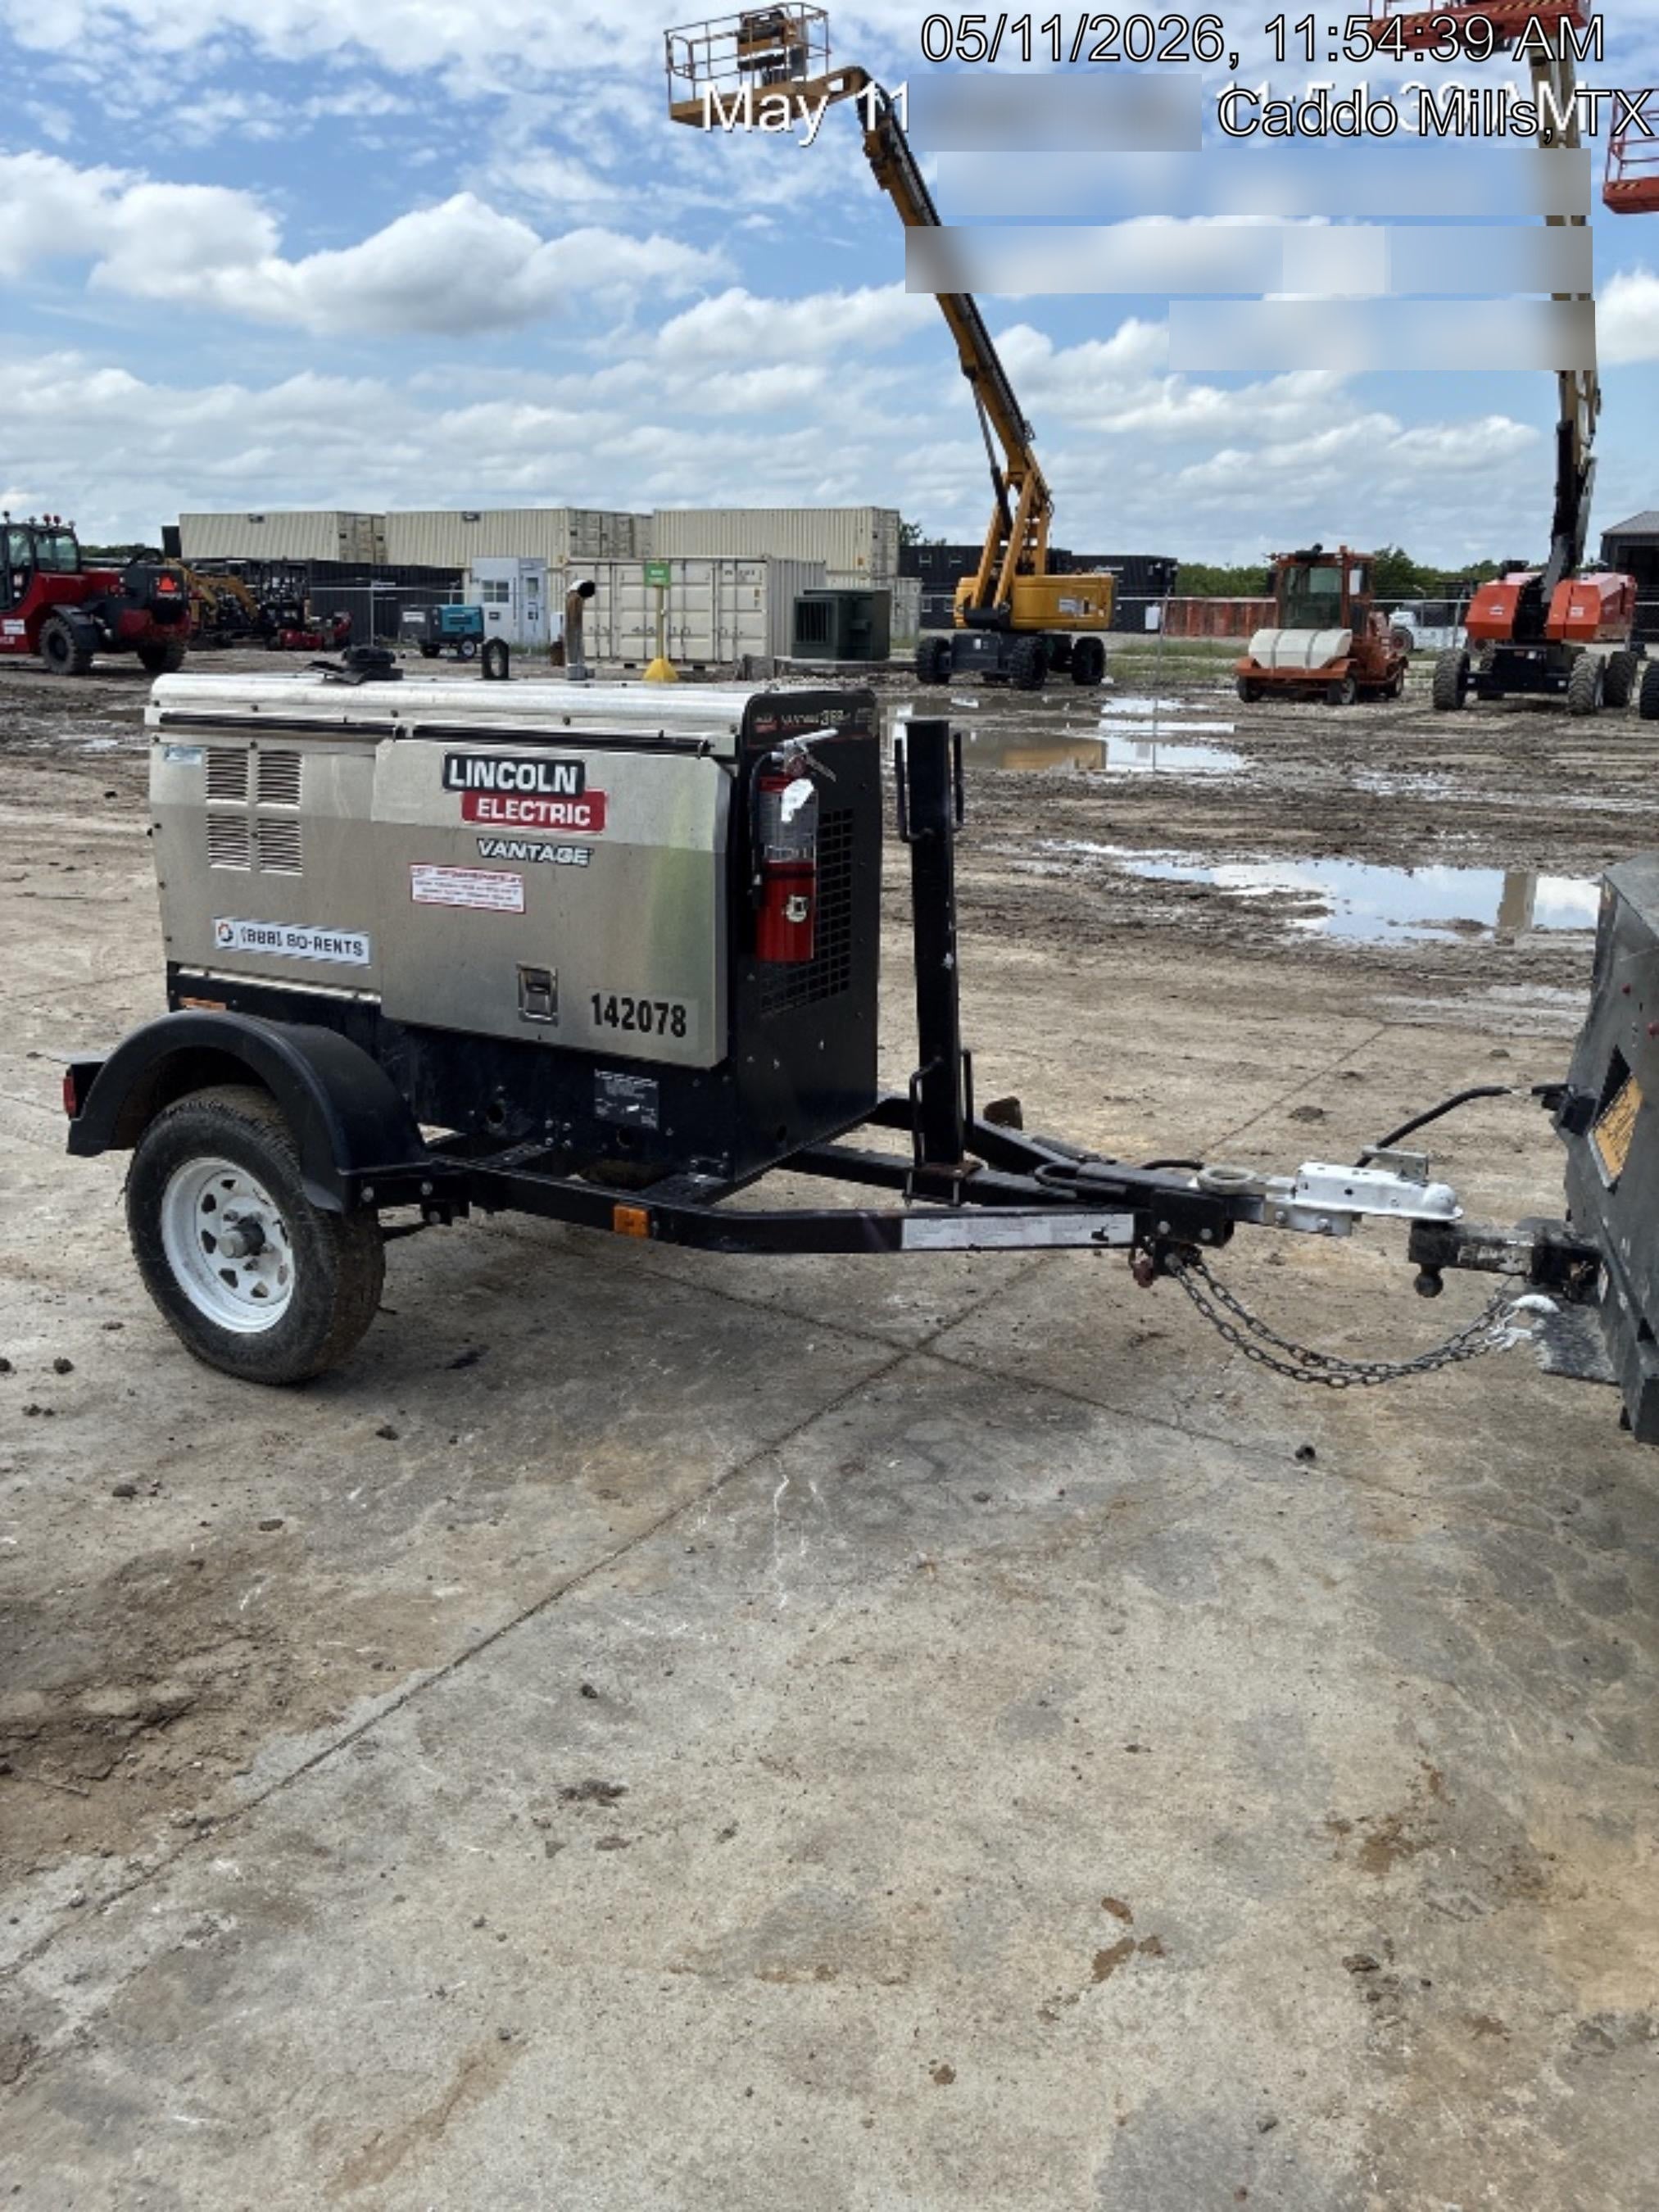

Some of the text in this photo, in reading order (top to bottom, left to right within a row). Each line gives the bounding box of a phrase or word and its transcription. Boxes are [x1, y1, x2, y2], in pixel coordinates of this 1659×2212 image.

[449, 759, 578, 795] LINCOLN
[476, 796, 592, 827] ELECTRIC
[477, 837, 594, 867] VANTAGE
[592, 992, 687, 1038] 142078
